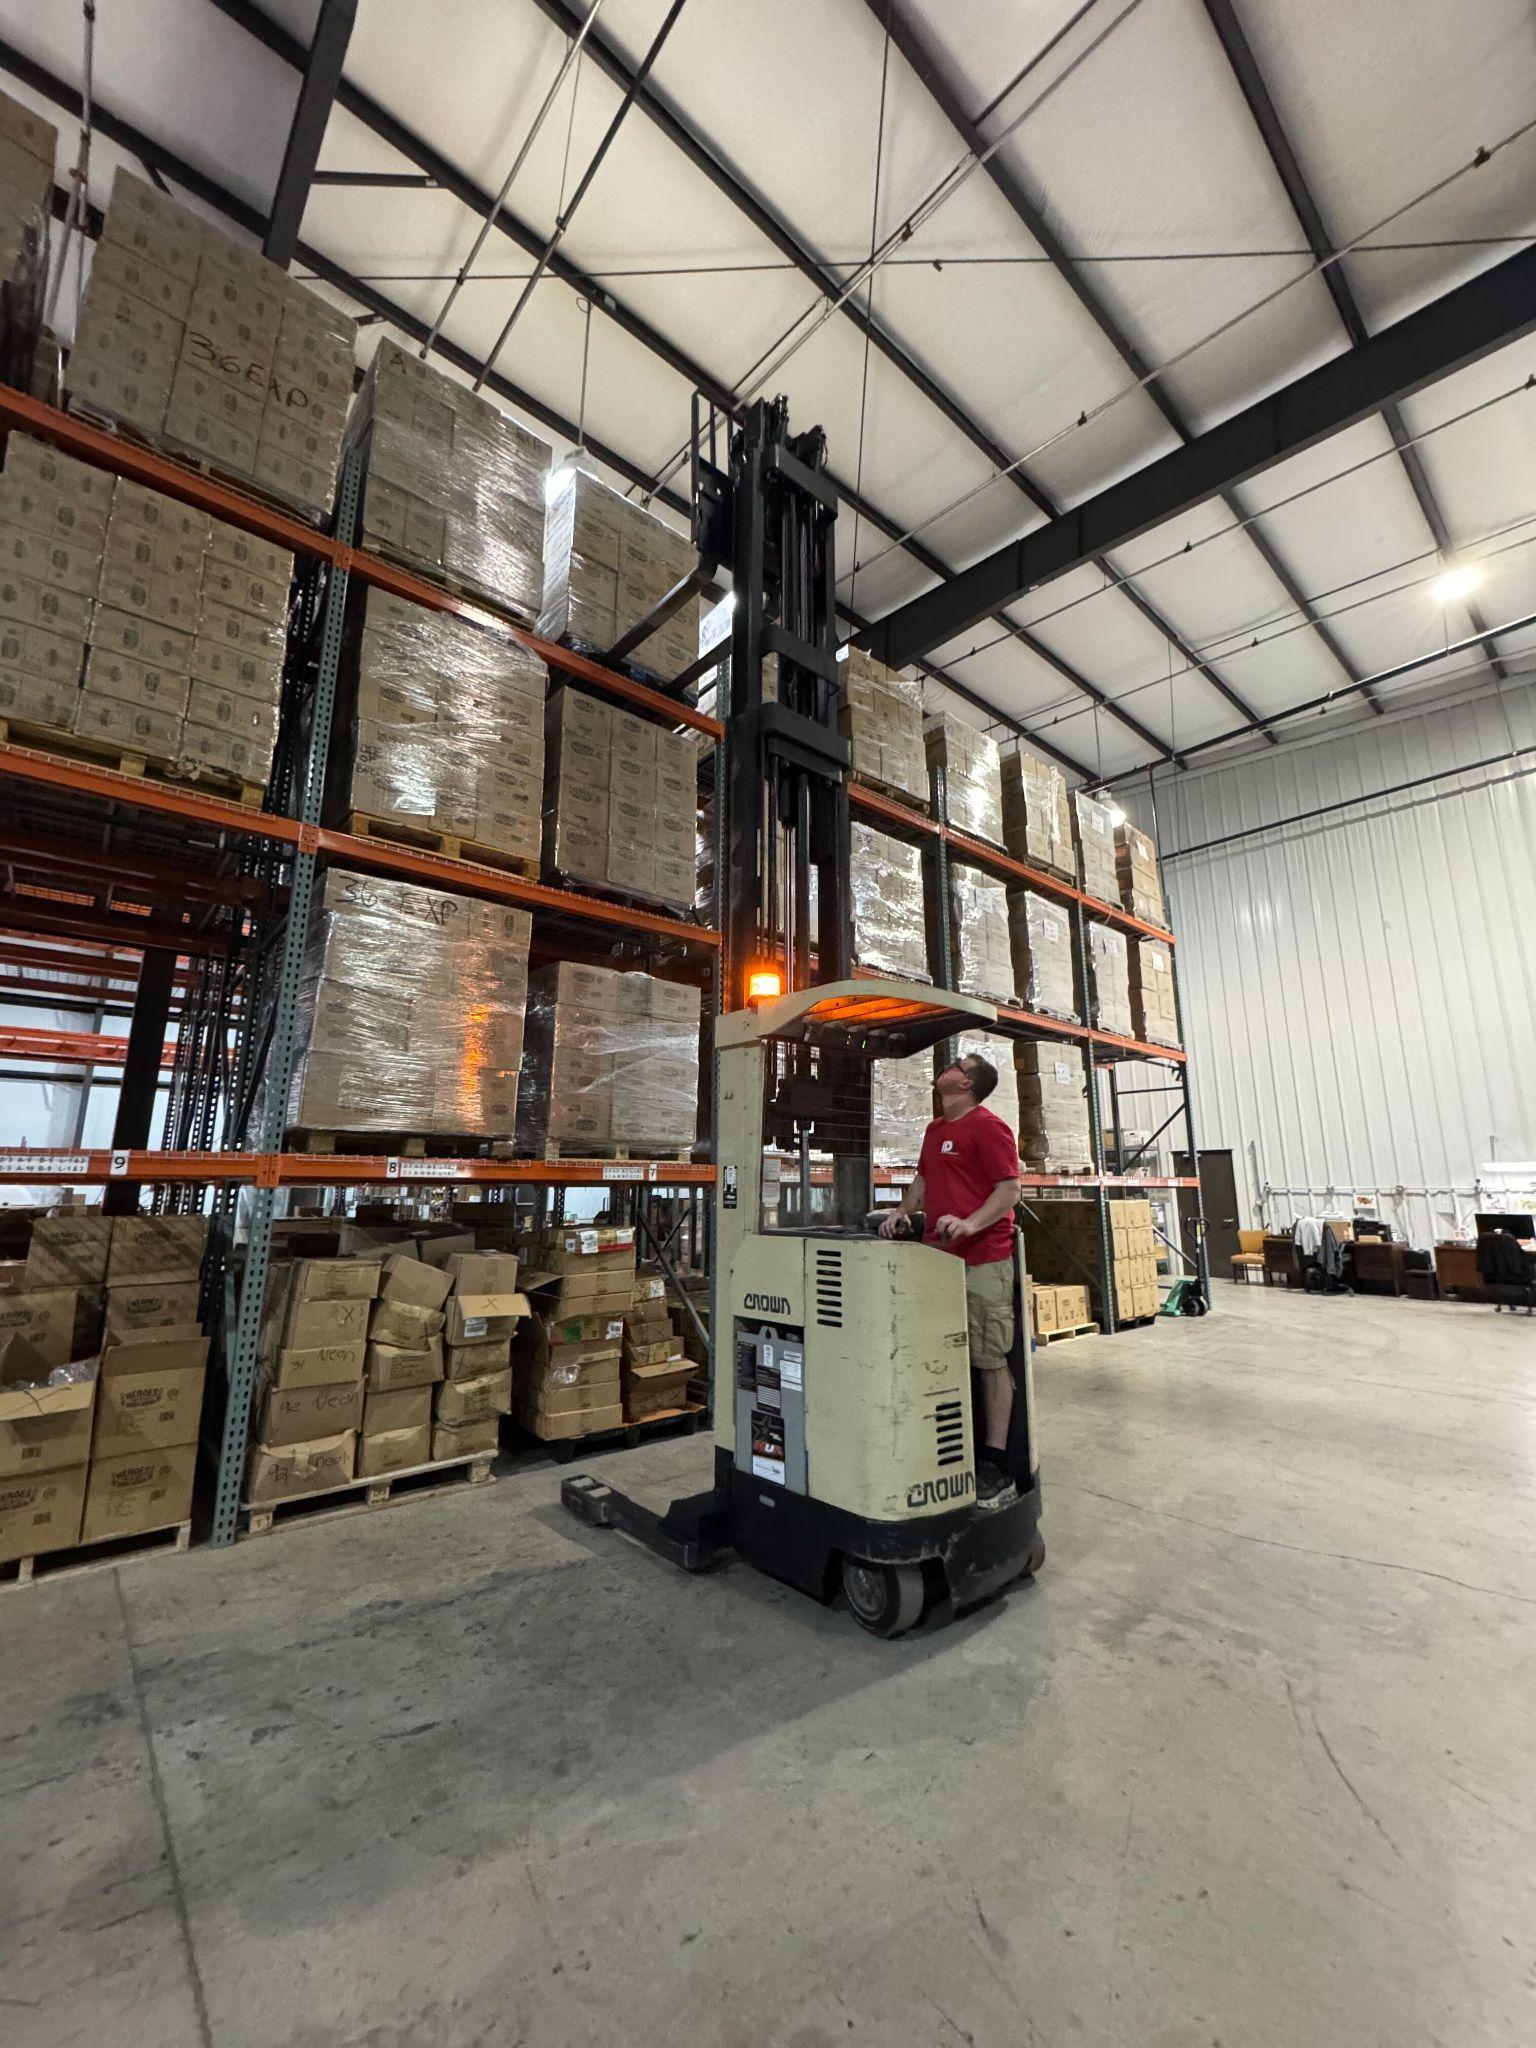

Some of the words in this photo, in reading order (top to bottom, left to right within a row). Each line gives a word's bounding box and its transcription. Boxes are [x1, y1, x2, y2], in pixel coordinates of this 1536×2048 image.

[114, 1156, 126, 1169] 9
[389, 1162, 397, 1173] 8
[650, 1168, 656, 1177] 7
